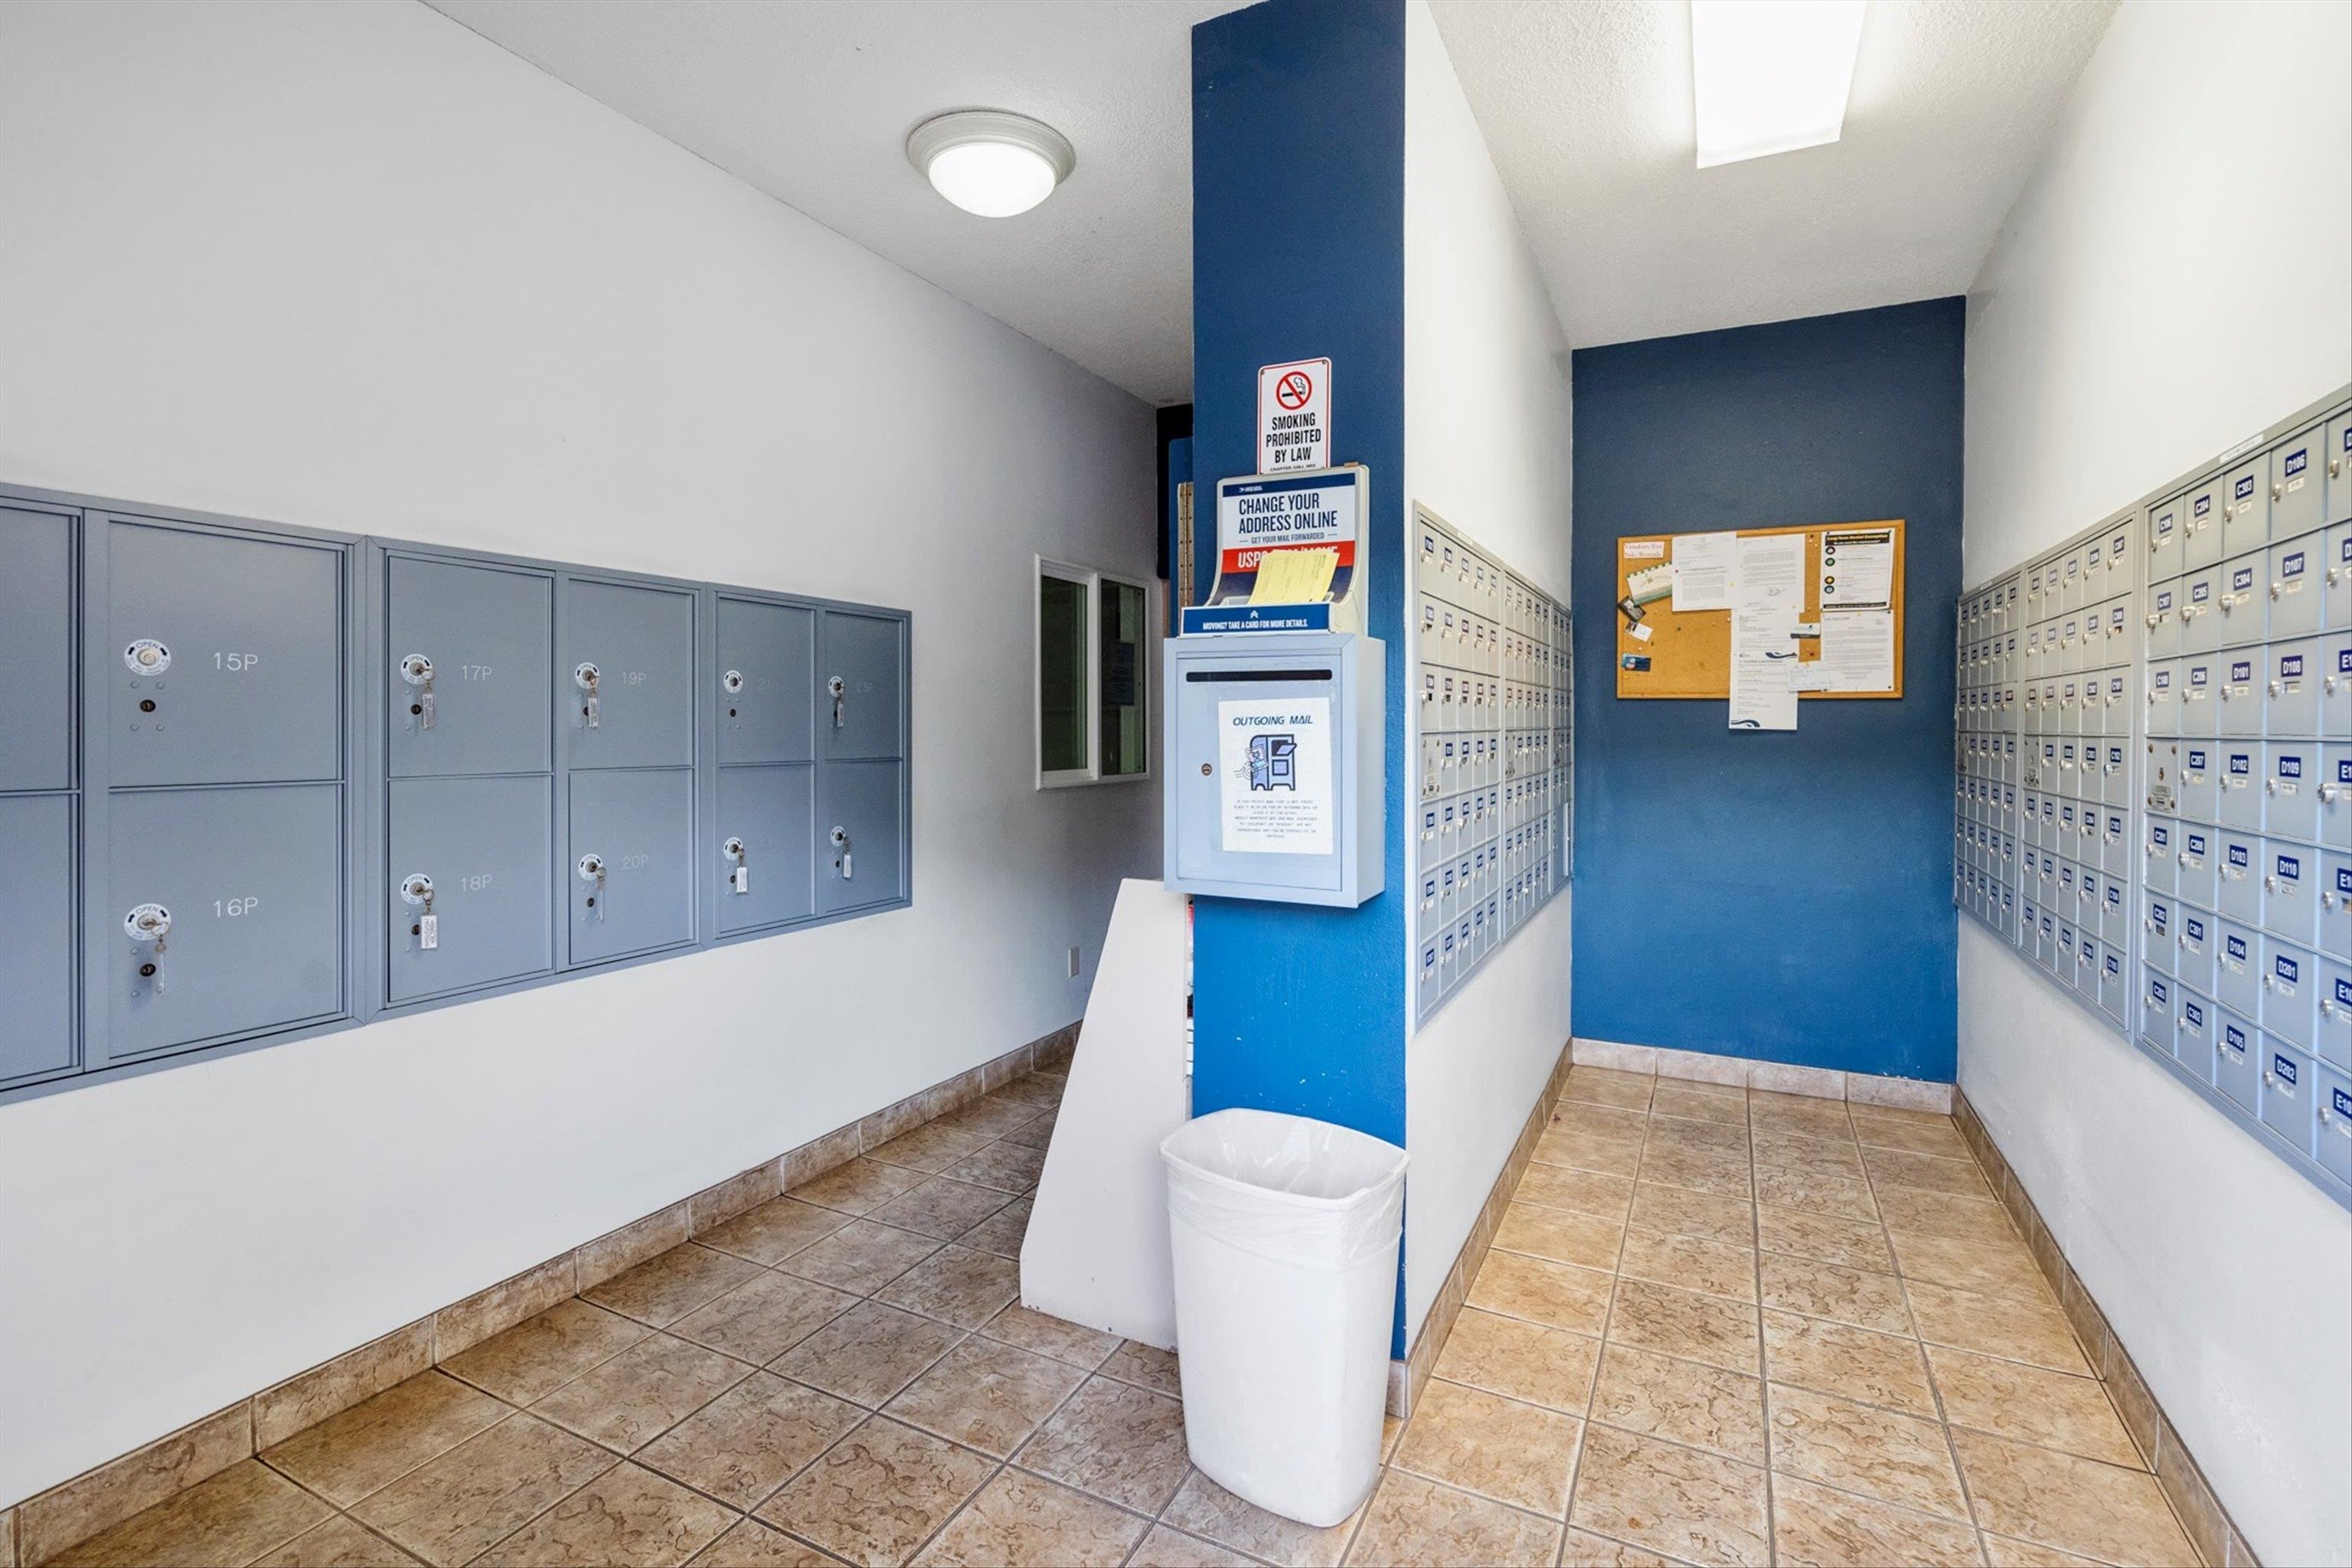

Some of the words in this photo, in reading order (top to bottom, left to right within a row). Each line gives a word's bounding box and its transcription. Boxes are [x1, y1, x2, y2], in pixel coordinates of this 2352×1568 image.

[1272, 413, 1315, 430] SMOKING
[1266, 429, 1321, 447] PROHIBITED
[1275, 449, 1287, 463] BY
[1291, 446, 1312, 461] LAW
[2287, 453, 2305, 474] D106
[2236, 479, 2252, 496] C303
[1239, 496, 1285, 515] CHANGE
[1288, 493, 1319, 511] YOUR
[1239, 514, 1291, 534] ADDRESS
[1295, 511, 1338, 530] ONLINE
[1291, 532, 1325, 541] FORWARDED
[2285, 557, 2303, 573] D107
[2235, 572, 2251, 586] C304
[1203, 622, 1227, 630] MOVING?
[1246, 620, 1259, 629] CARD
[1270, 619, 1285, 628] MORE
[214, 652, 258, 671] 15P
[2283, 661, 2301, 675] D108
[2342, 655, 2352, 668] E1
[462, 665, 492, 680] 17P
[622, 671, 646, 685] 19P
[2234, 666, 2249, 679] D101
[1233, 716, 1285, 726] OUTGOING
[1289, 715, 1313, 724] MAIL
[2232, 759, 2247, 771] D102
[2281, 761, 2299, 775] D109
[2341, 765, 2352, 779] E1
[623, 854, 648, 870] 20P
[2231, 850, 2246, 864] D103
[2279, 860, 2297, 875] D110
[461, 874, 492, 892] 18P
[136, 906, 159, 914] OPEN
[214, 897, 258, 918] 16P
[2278, 962, 2296, 978] D201
[2277, 1060, 2295, 1080] D202
[2336, 1095, 2352, 1115] E10
